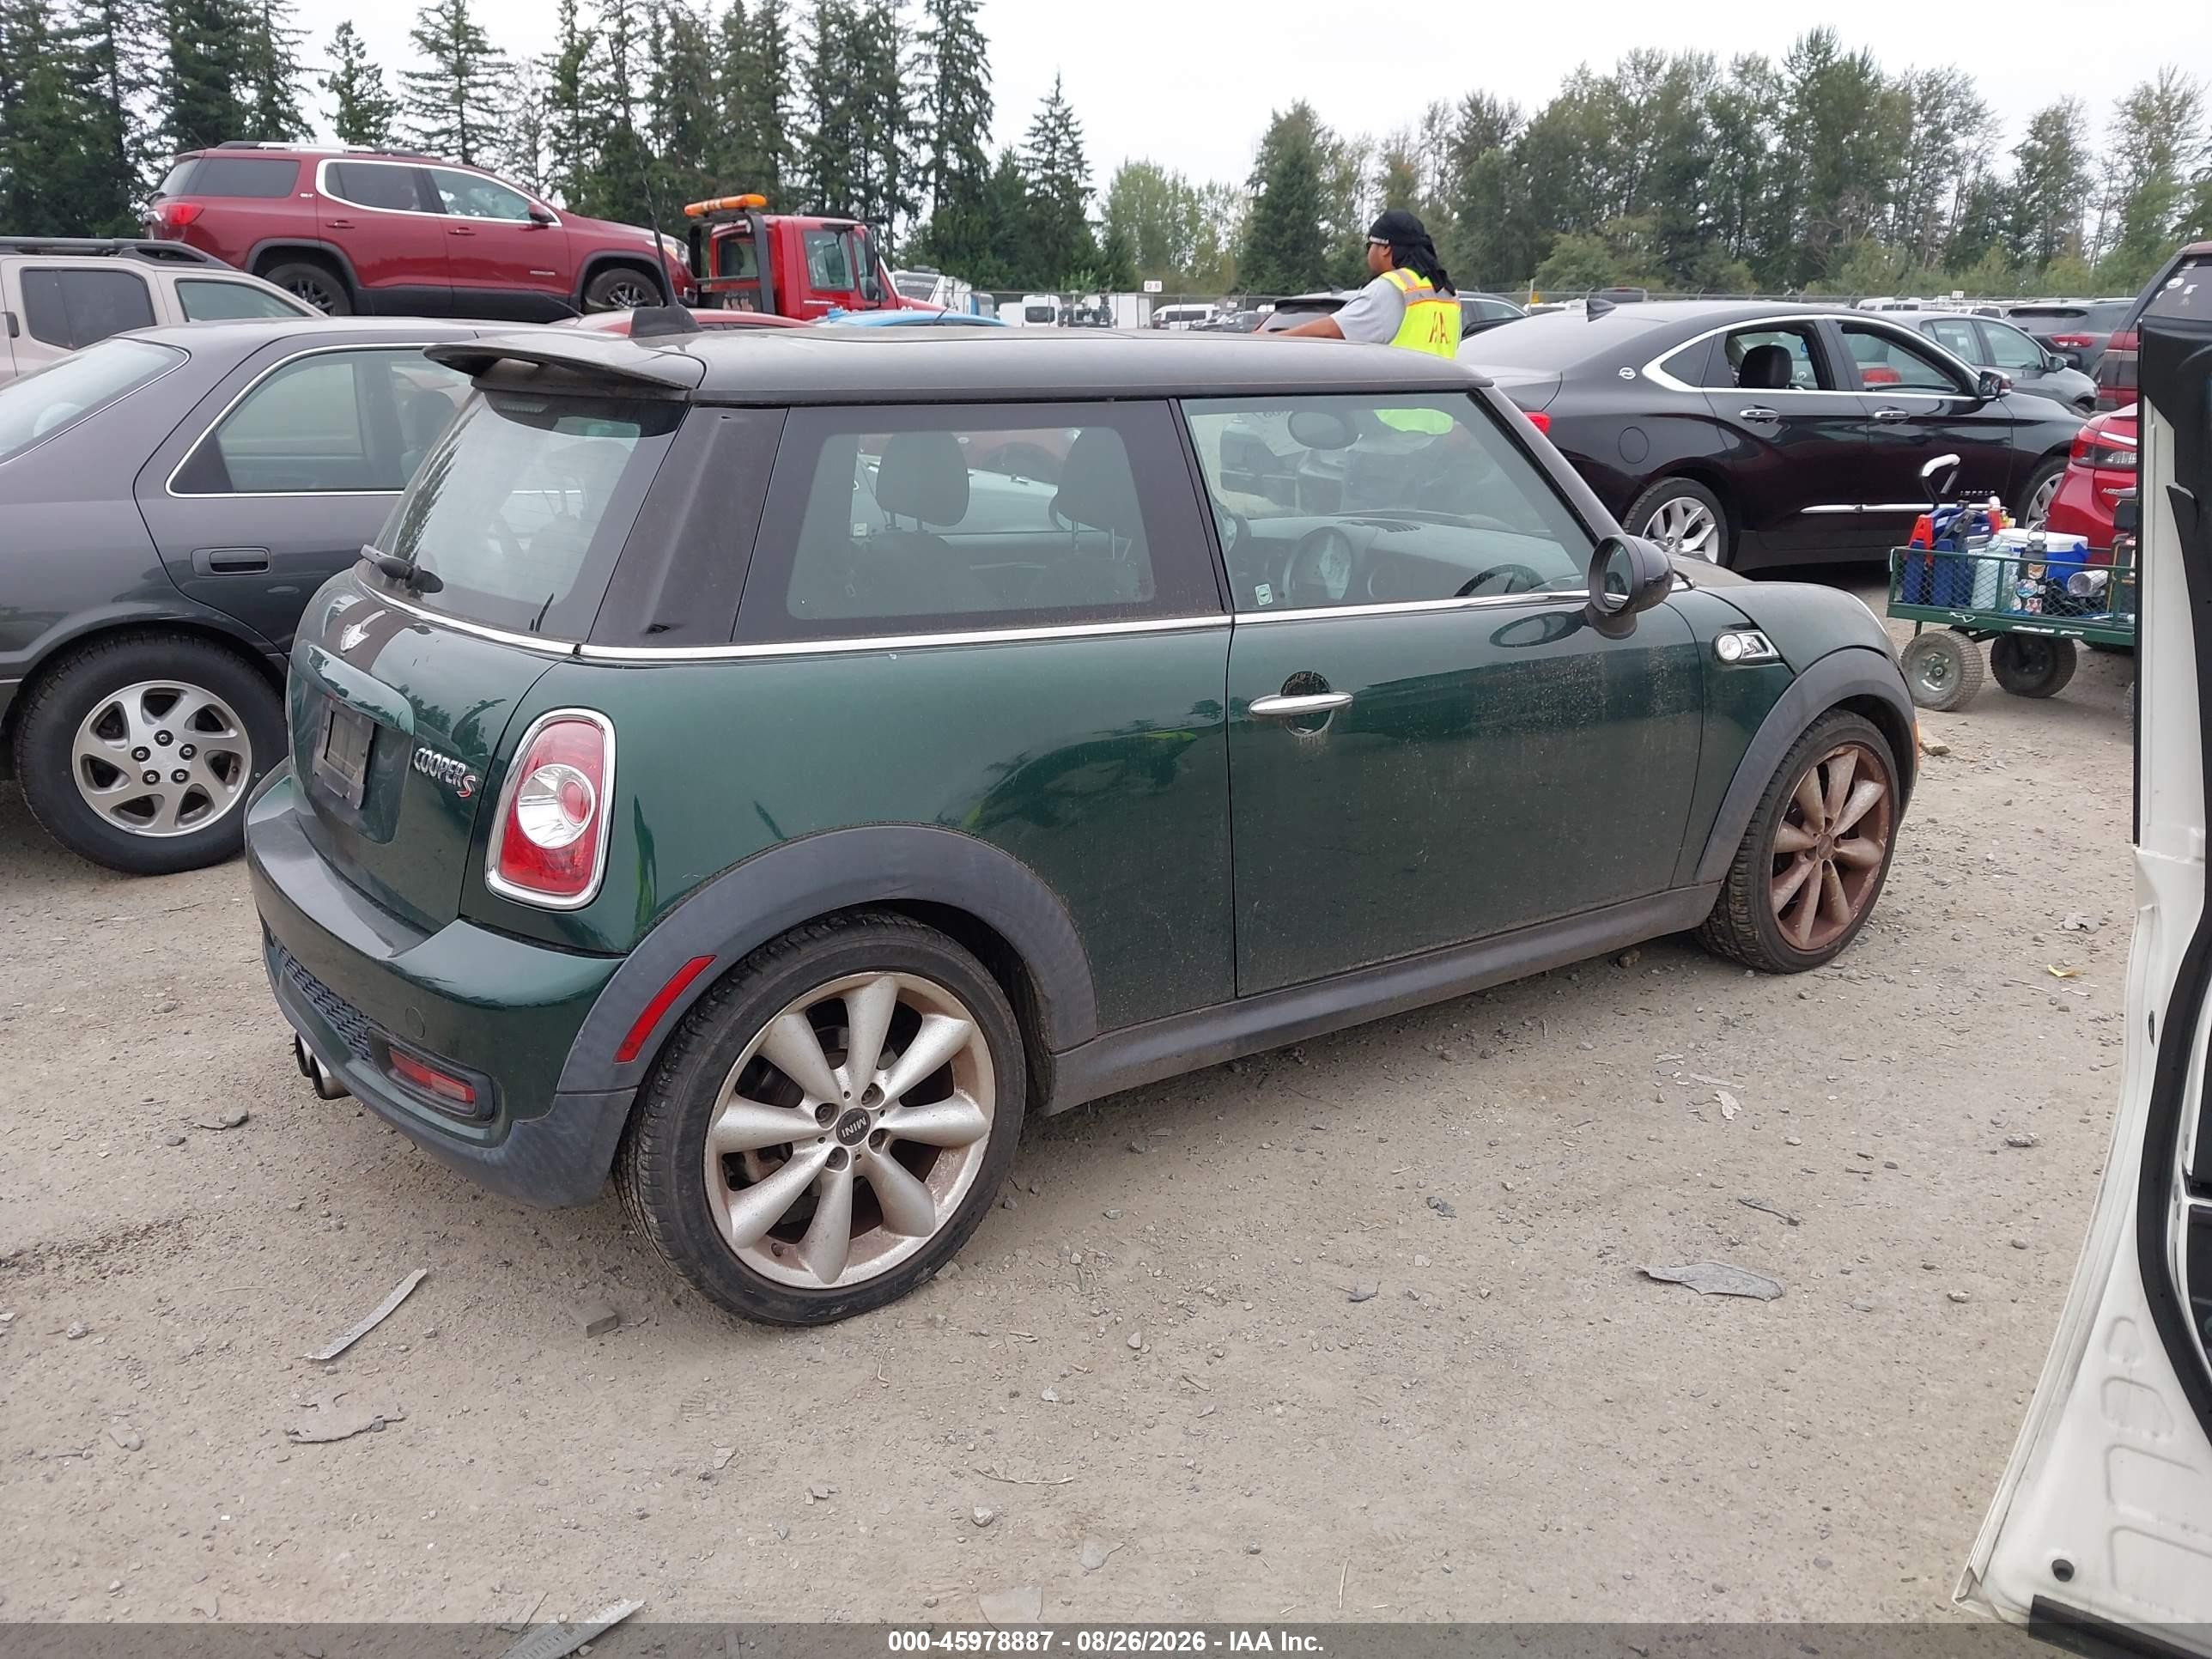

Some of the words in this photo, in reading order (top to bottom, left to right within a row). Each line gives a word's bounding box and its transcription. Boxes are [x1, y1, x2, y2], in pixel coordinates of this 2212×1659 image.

[413, 748, 466, 787] COOPER
[456, 775, 477, 798] S
[841, 1116, 867, 1138] MINI
